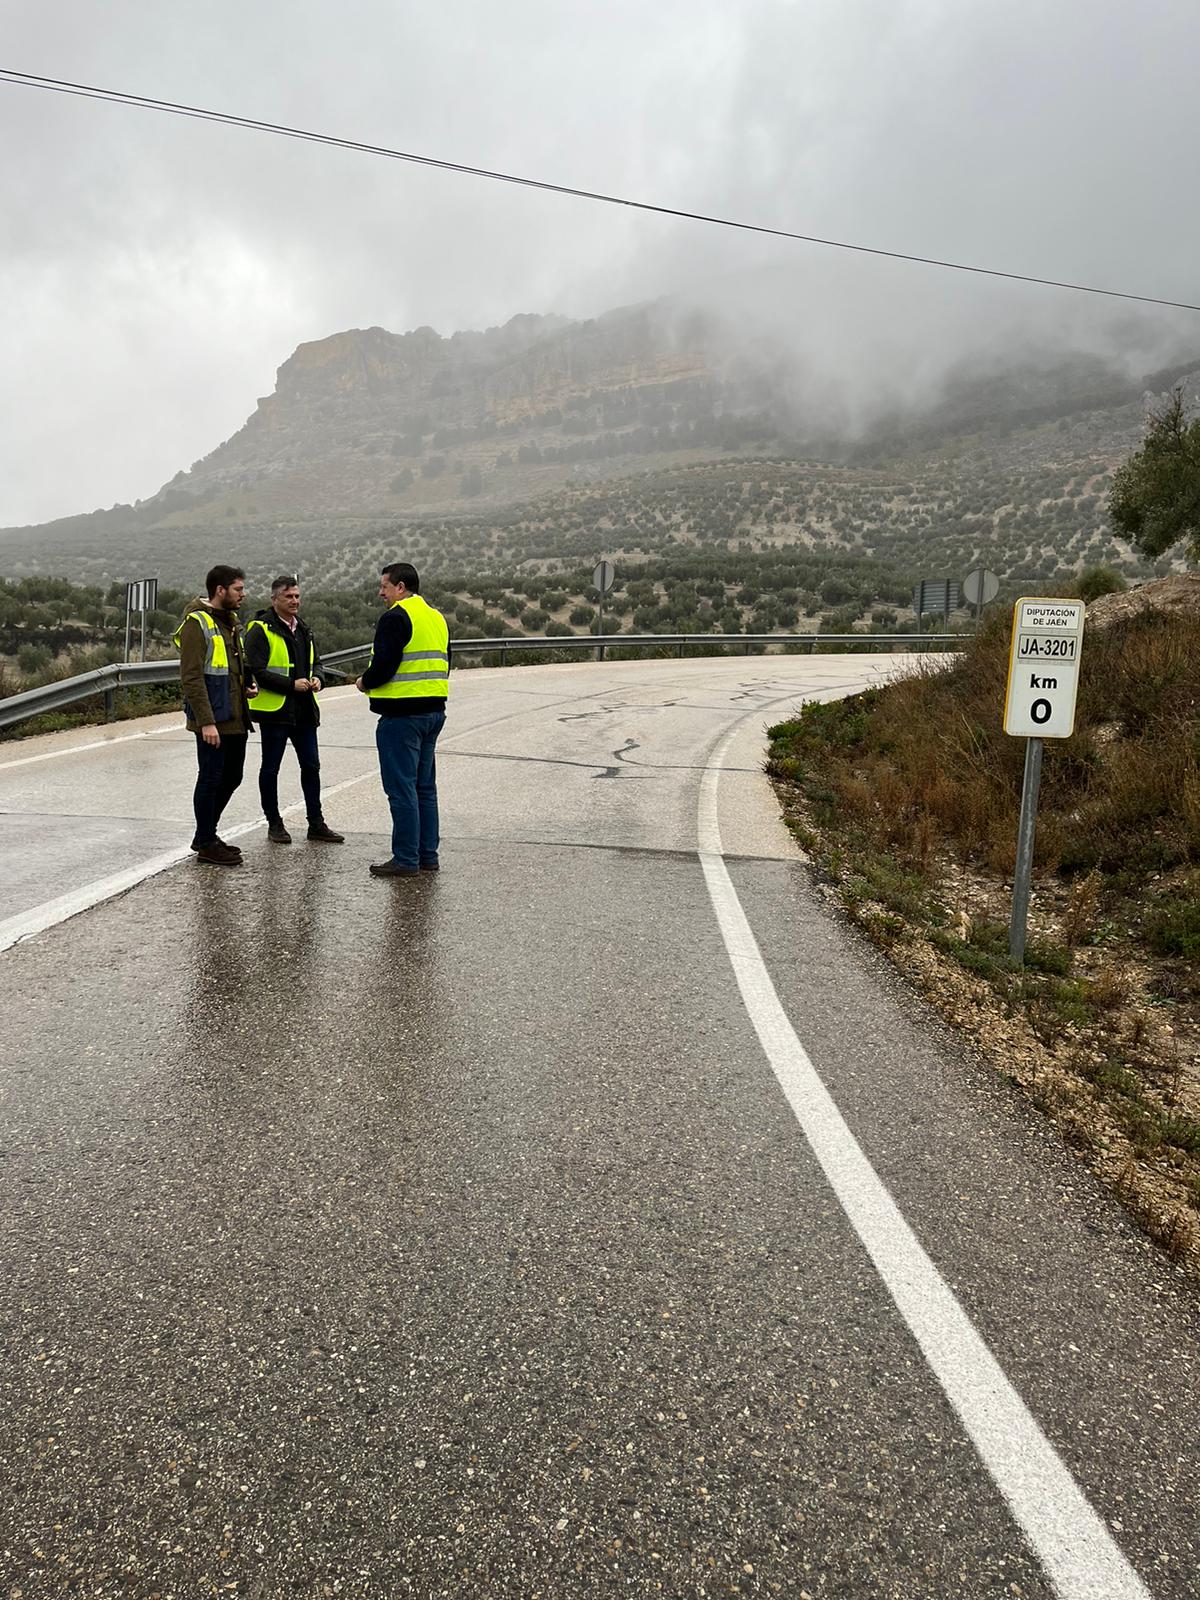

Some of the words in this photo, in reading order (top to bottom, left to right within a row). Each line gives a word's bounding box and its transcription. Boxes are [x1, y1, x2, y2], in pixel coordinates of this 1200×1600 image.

[1026, 608, 1076, 617] DIPUTACIÓN
[1032, 618, 1045, 626] DE
[1045, 617, 1068, 626] JAÉN
[1021, 638, 1075, 657] JA-3201
[1030, 673, 1058, 689] km
[1030, 697, 1052, 724] 0
